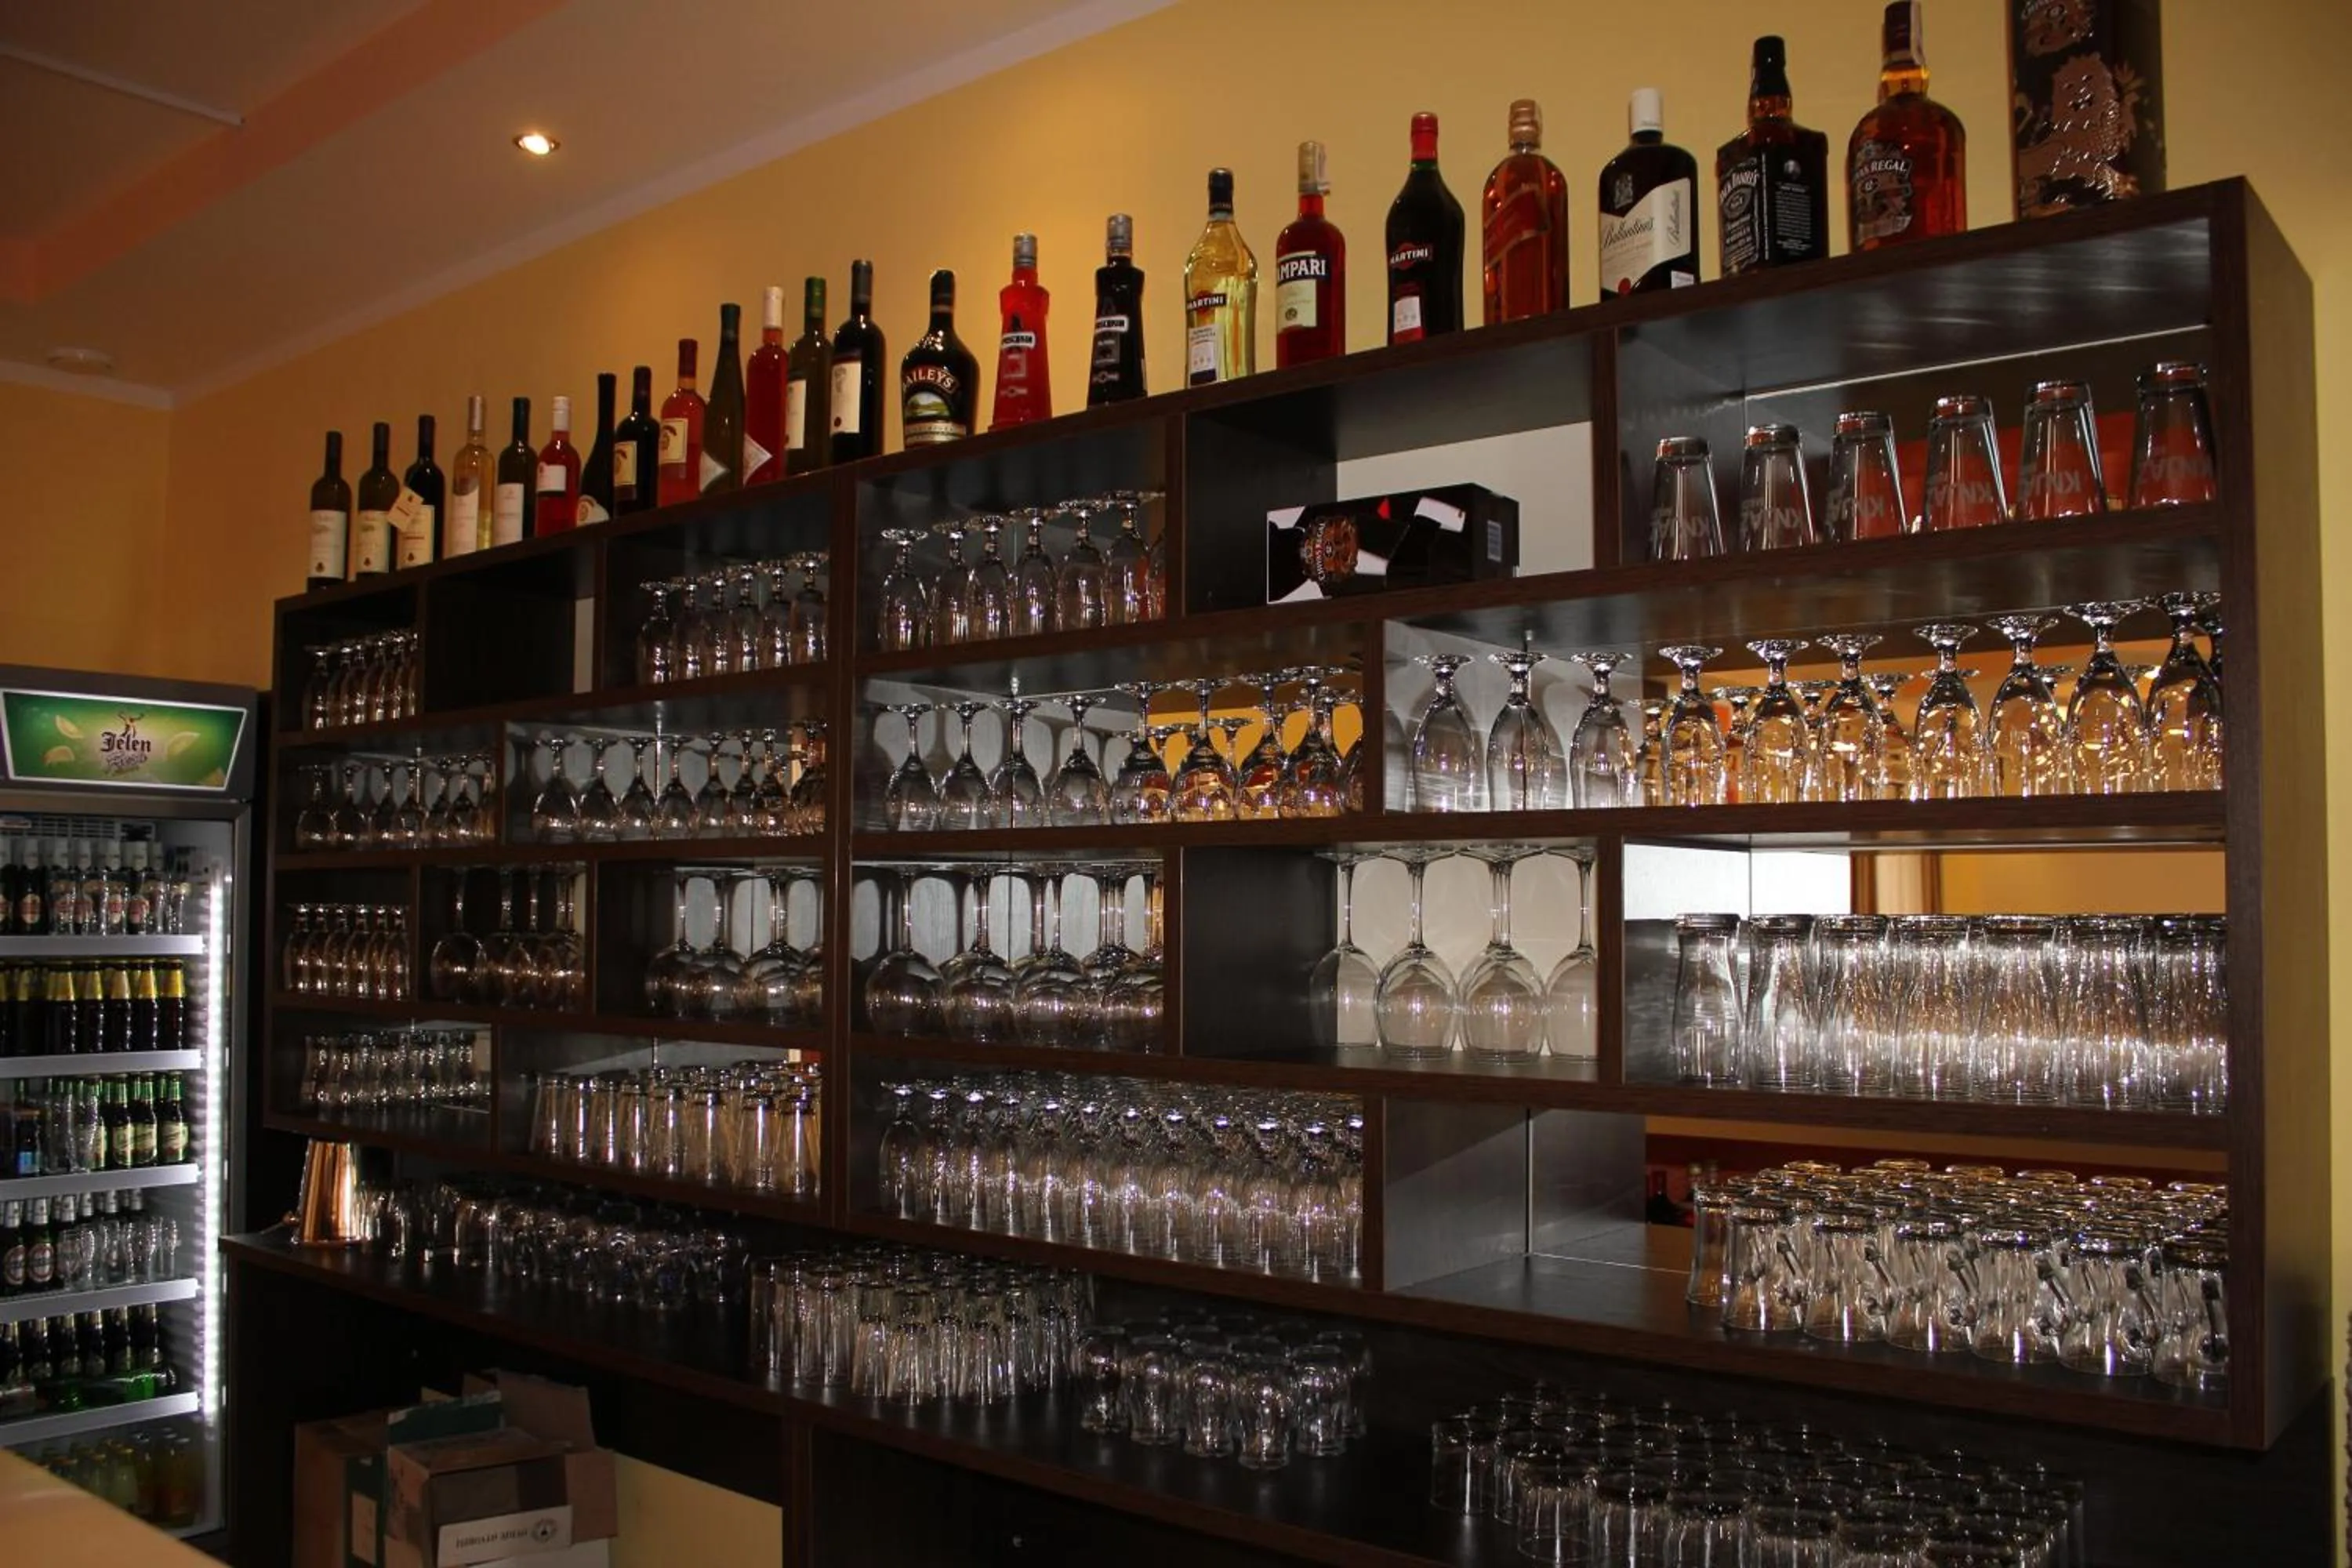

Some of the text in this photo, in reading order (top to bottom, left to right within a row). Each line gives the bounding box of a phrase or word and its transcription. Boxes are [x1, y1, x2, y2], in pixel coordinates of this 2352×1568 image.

[1871, 159, 1907, 172] REGAL
[1277, 259, 1327, 282] MPARI
[100, 731, 152, 753] Jelen
